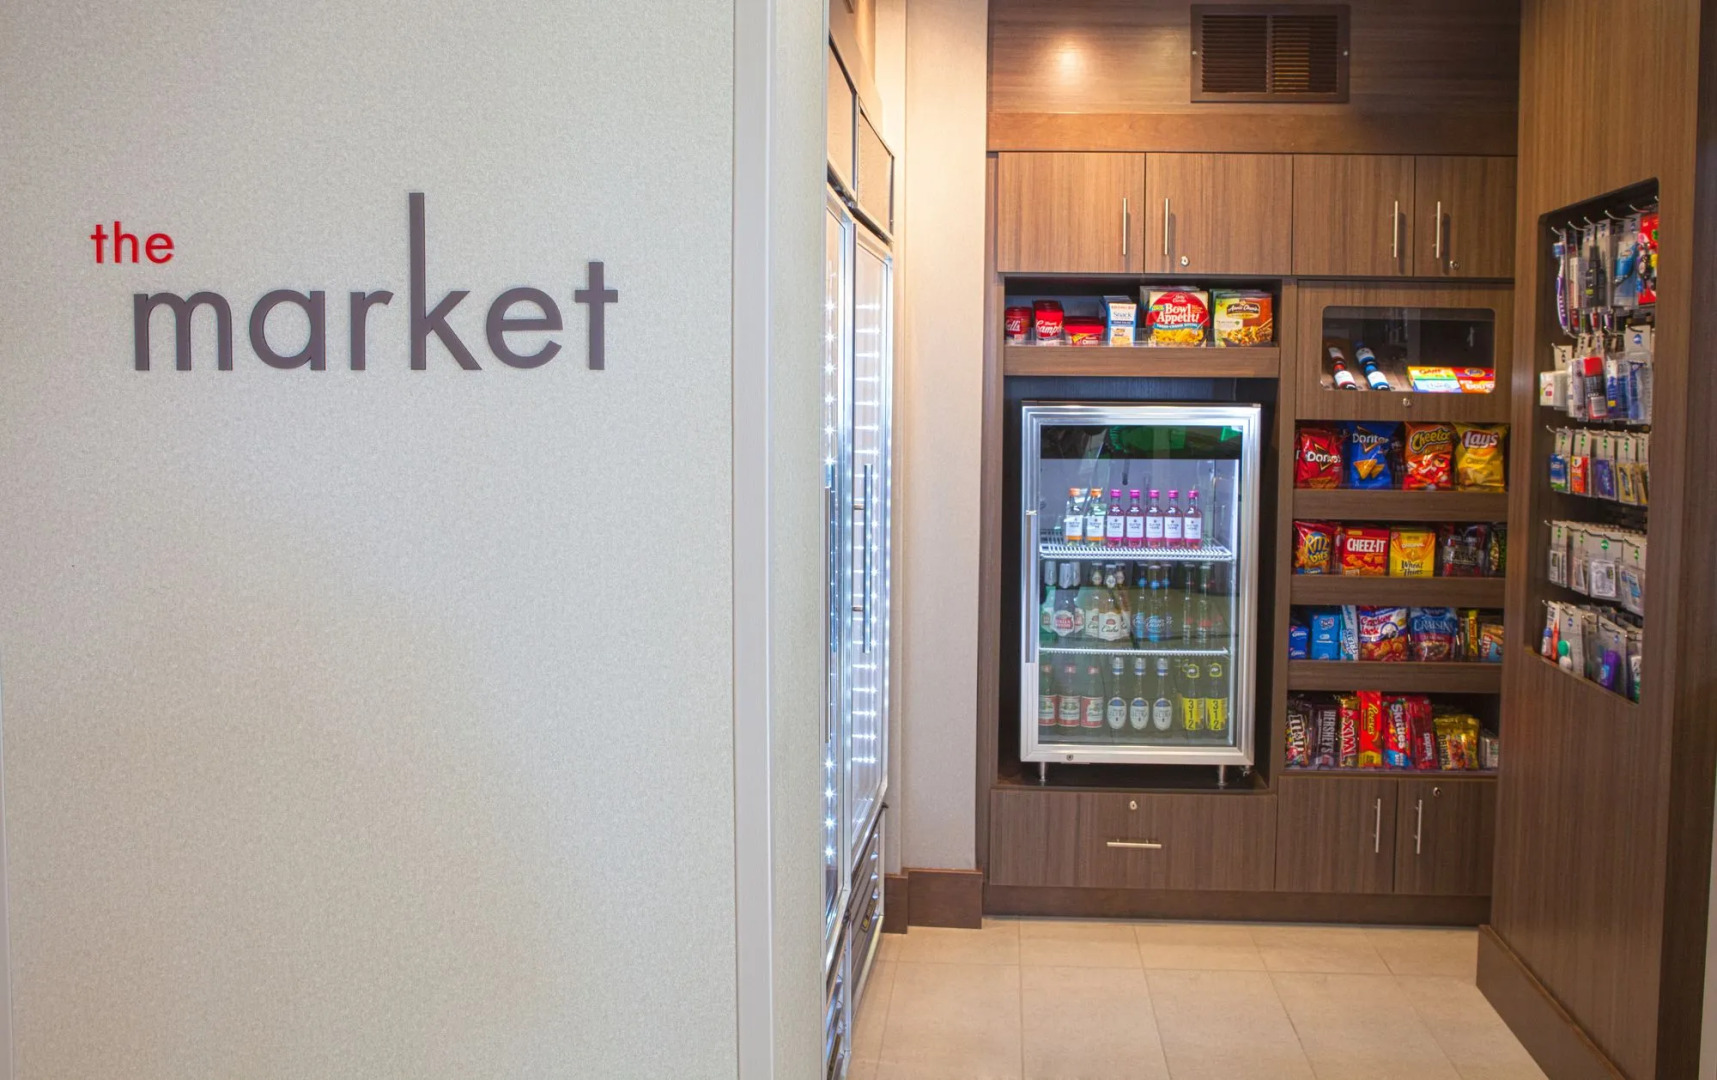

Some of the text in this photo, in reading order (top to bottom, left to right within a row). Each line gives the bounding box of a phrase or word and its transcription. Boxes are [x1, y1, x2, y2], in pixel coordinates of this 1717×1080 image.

[90, 221, 175, 264] the
[133, 192, 618, 371] market
[1165, 302, 1192, 314] Bowl
[1346, 538, 1386, 553] CHEEZ-IT
[1391, 703, 1406, 749] Skittles
